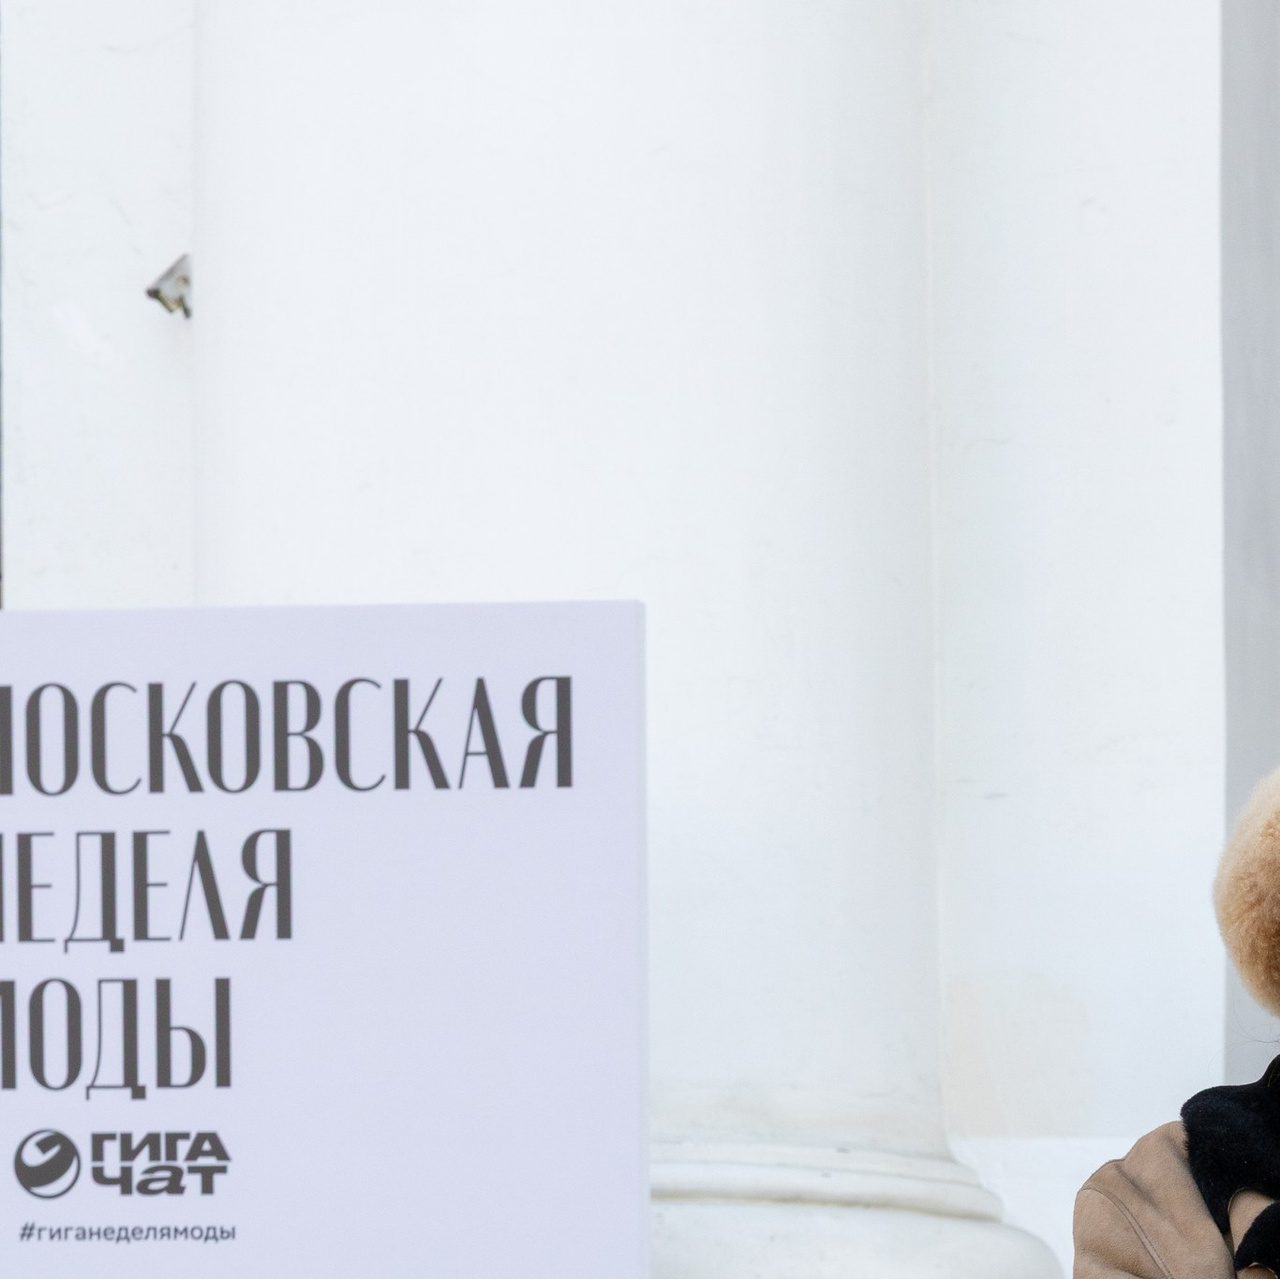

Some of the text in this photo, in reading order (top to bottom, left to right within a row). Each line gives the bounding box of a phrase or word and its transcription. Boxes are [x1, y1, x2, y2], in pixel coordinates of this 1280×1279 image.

[0, 676, 572, 796] ОСКОВСКАЯ
[0, 829, 292, 953] ЕДЕЛЯ
[0, 978, 231, 1100] ОДЫ
[91, 1132, 231, 1162] ГИГА
[20, 1222, 237, 1244] #гиганеделямоды
